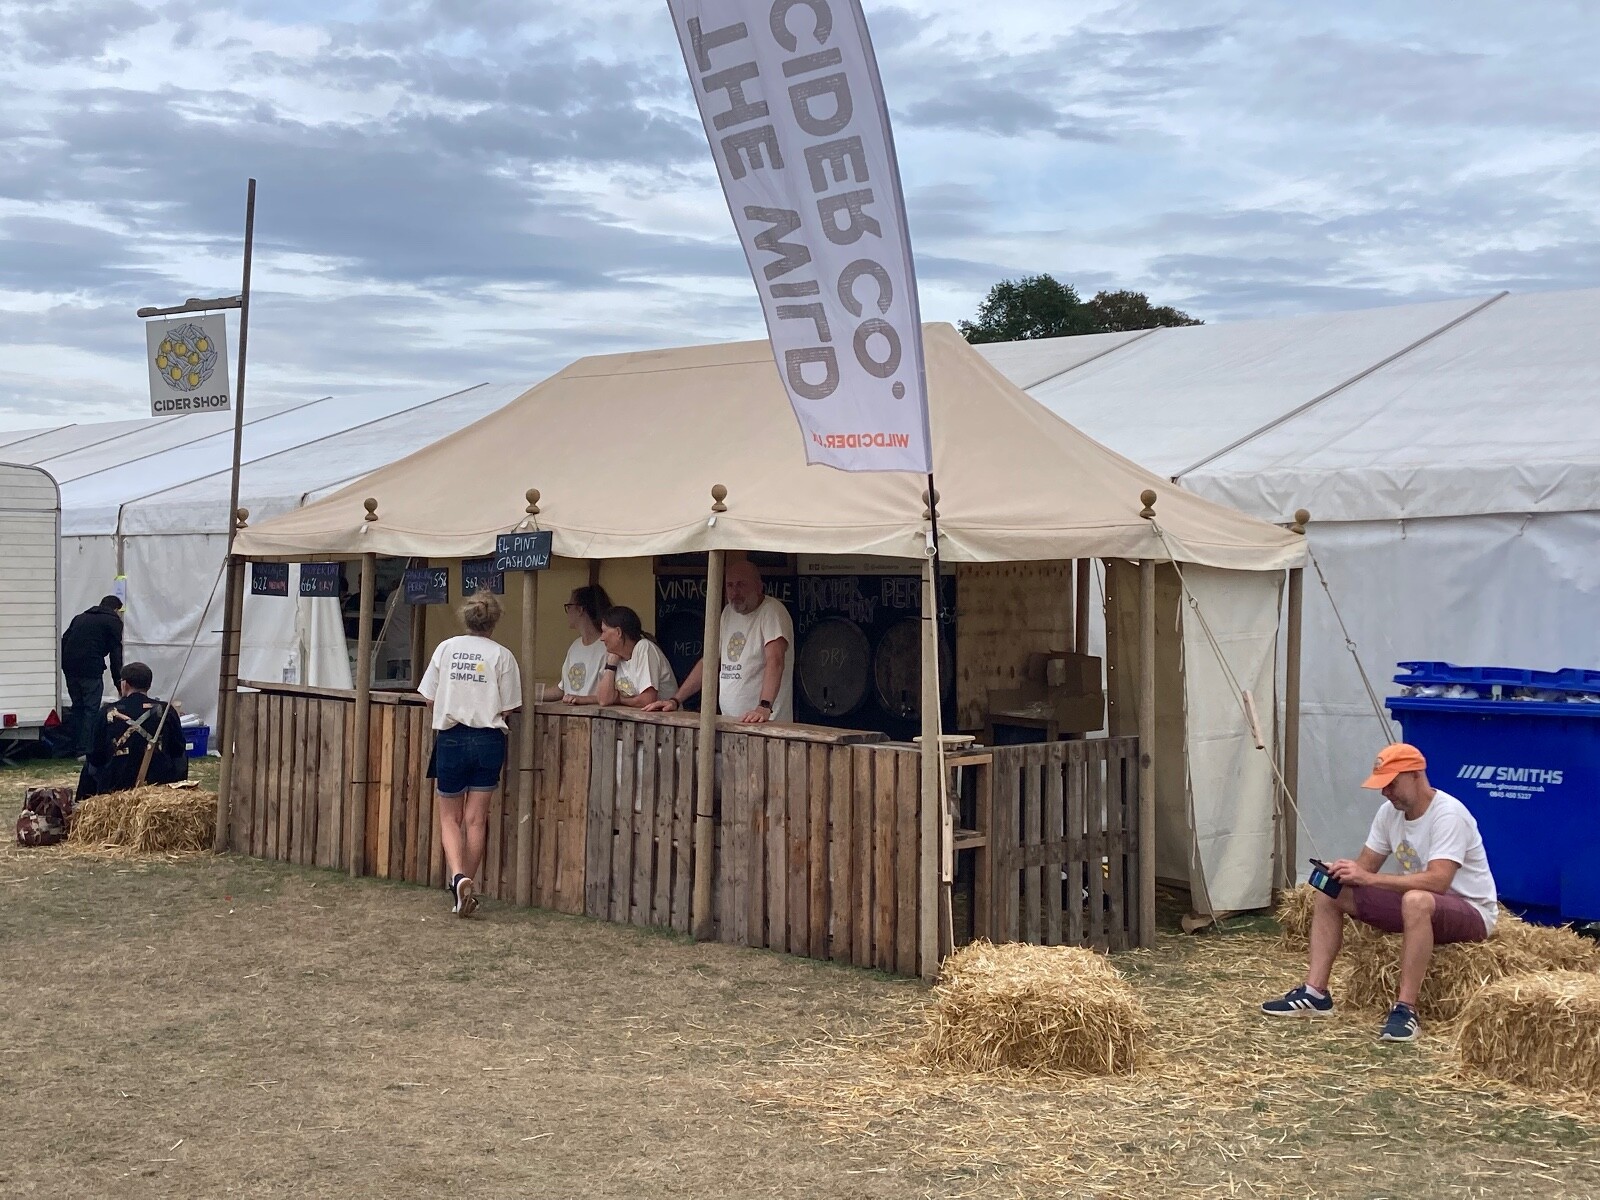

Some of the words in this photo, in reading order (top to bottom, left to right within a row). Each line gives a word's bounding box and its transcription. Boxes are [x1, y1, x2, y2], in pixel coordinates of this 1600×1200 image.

[153, 398, 191, 412] CIDER
[193, 394, 228, 409] SHOP
[514, 536, 538, 552] PINT
[496, 555, 523, 571] CASH
[524, 554, 549, 568] ONLY
[657, 578, 706, 601] VINTAG
[452, 652, 485, 662] CIDER.
[818, 647, 849, 669] DRY
[449, 672, 488, 683] SIMPLE.
[1496, 766, 1564, 785] SMITHS
